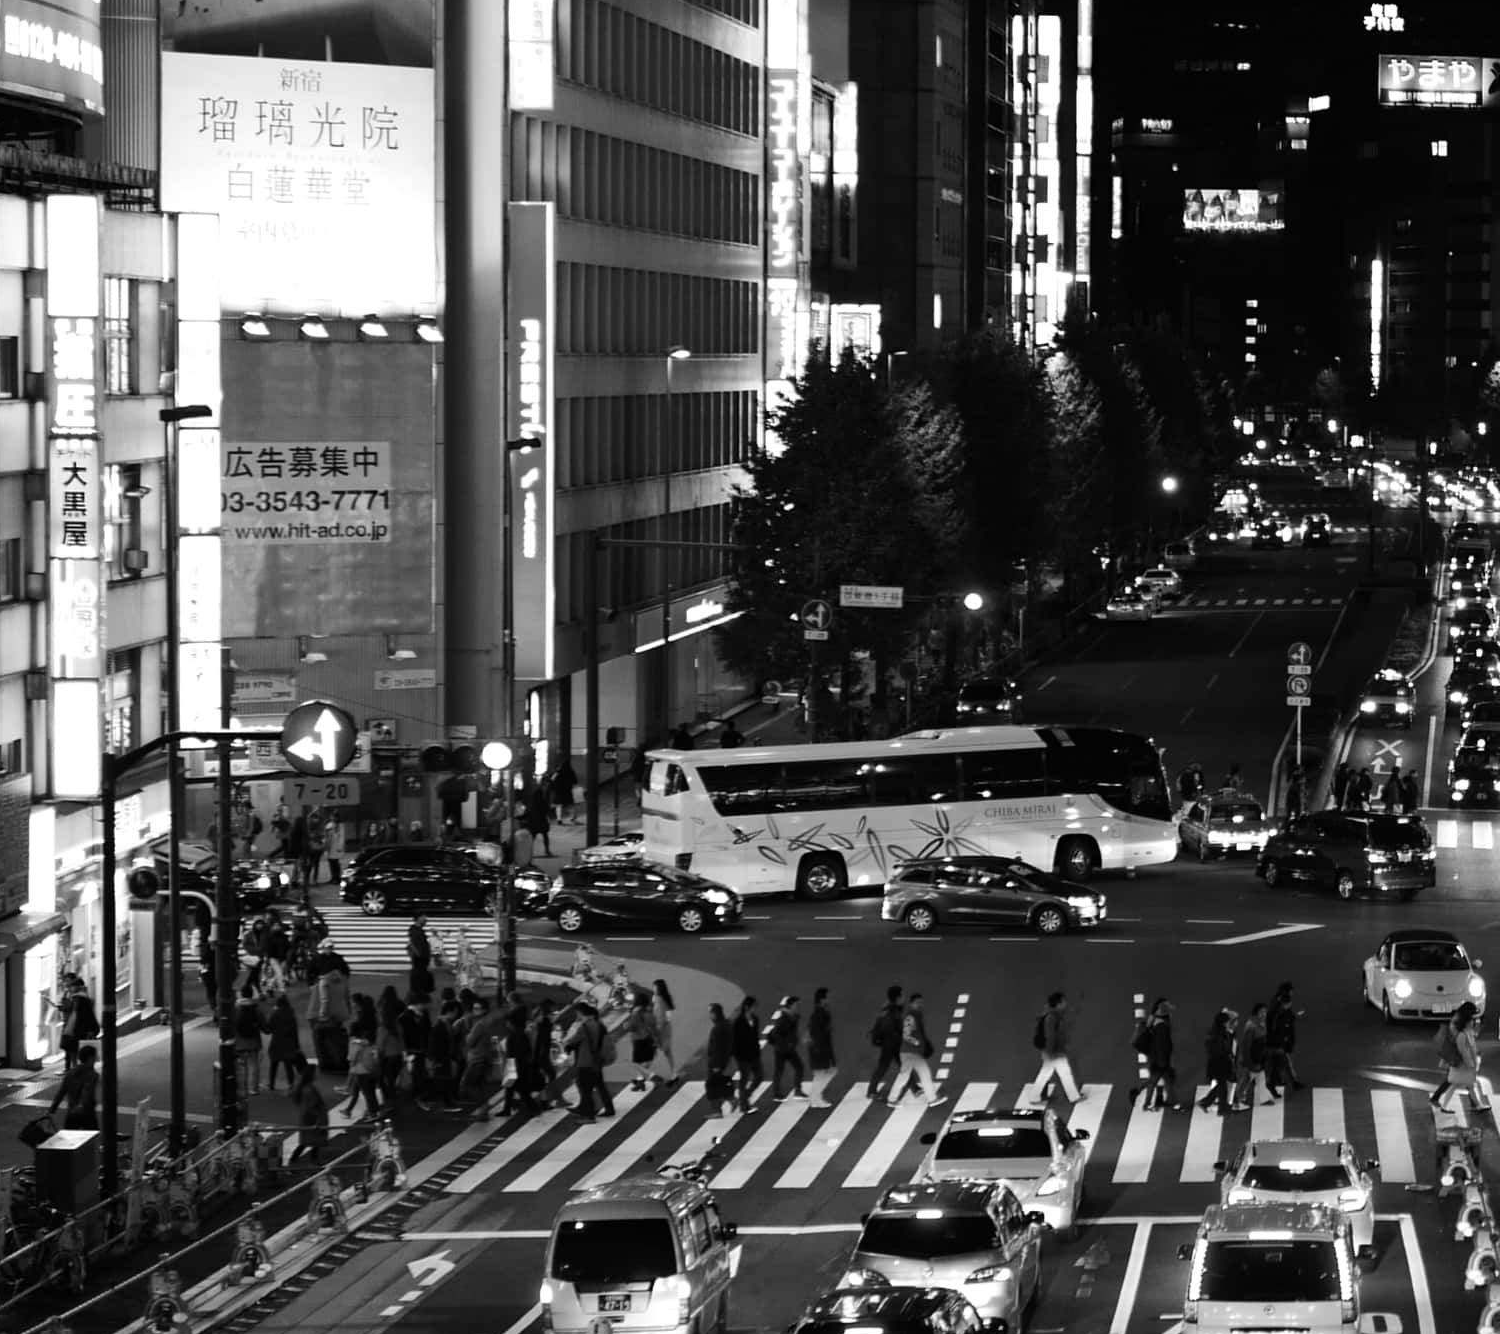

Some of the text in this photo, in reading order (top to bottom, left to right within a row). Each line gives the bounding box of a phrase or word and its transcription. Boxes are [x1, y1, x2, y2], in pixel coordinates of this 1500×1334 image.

[279, 67, 323, 93] 新宿
[1387, 59, 1477, 89] やまや
[198, 96, 400, 151] 瑠璃光院
[228, 163, 371, 205] 白蓮華堂
[224, 445, 379, 479] 広告募集中
[62, 461, 88, 548] 大黒屋
[984, 803, 1057, 818] CHIBA MIRAI
